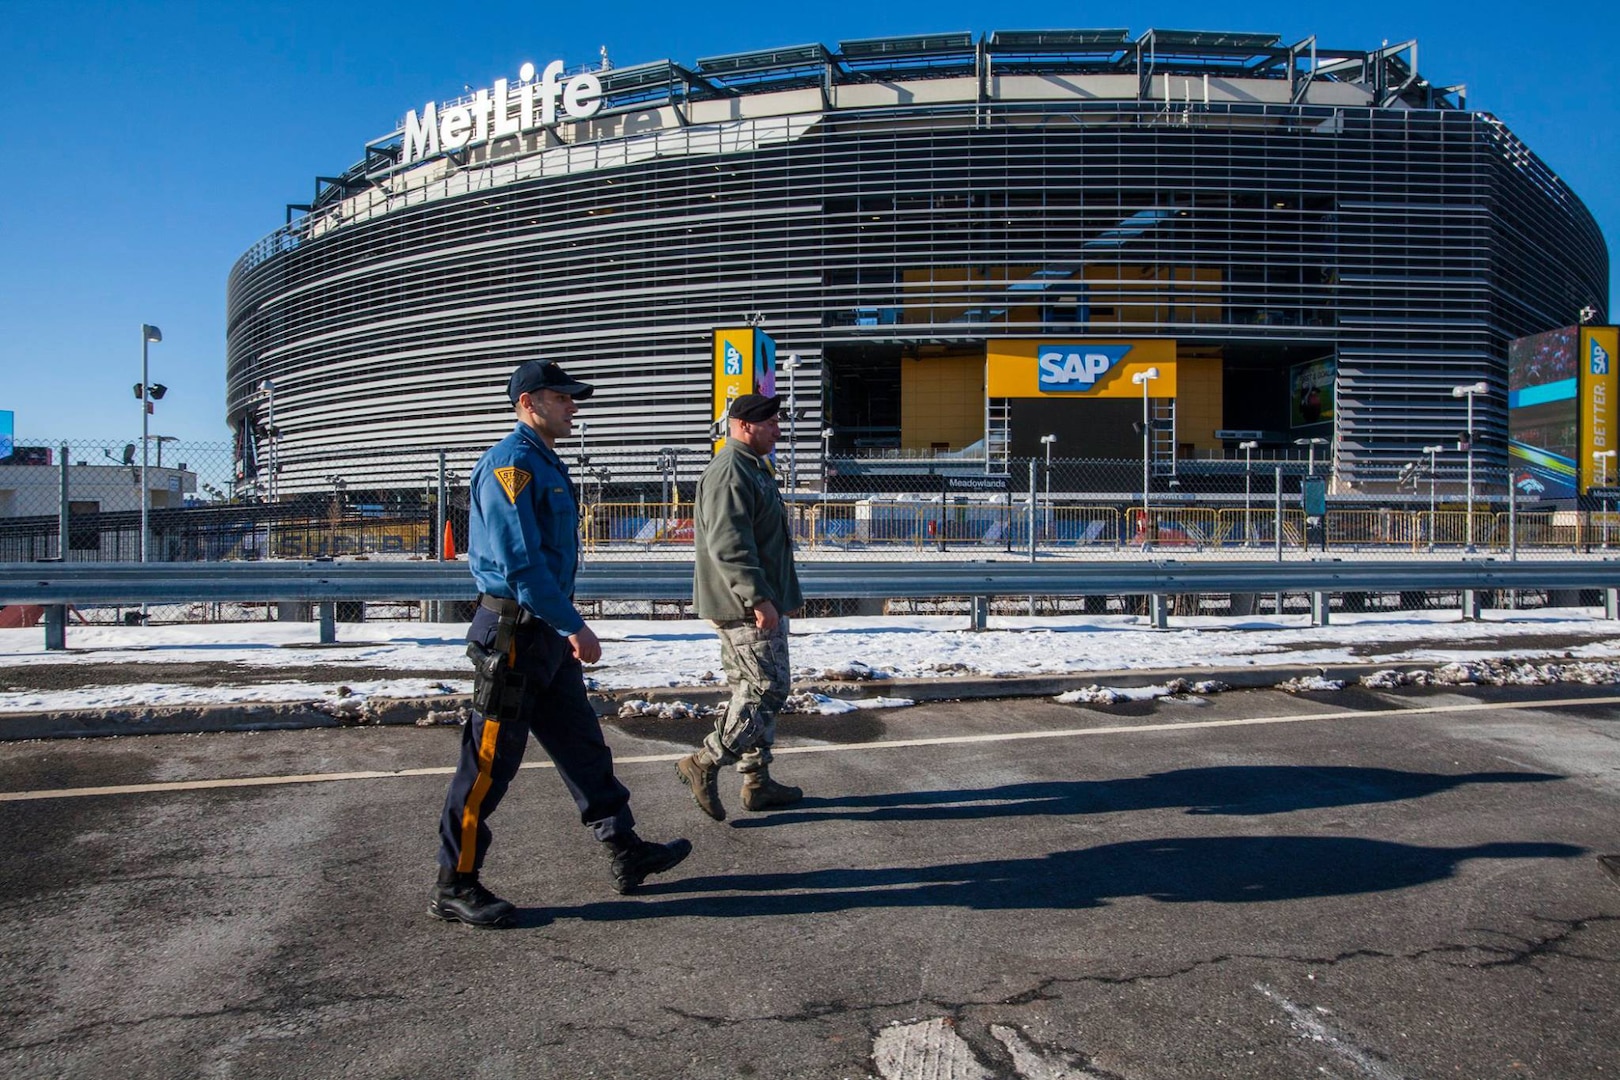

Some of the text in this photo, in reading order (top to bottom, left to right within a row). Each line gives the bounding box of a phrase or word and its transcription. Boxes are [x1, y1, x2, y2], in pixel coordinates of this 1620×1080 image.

[402, 60, 602, 164] MetLife
[727, 347, 740, 375] SAP
[1040, 352, 1109, 383] SAP
[1593, 345, 1606, 374] SAP
[1593, 382, 1606, 447] BETTER.
[949, 479, 1006, 488] Meadowlands
